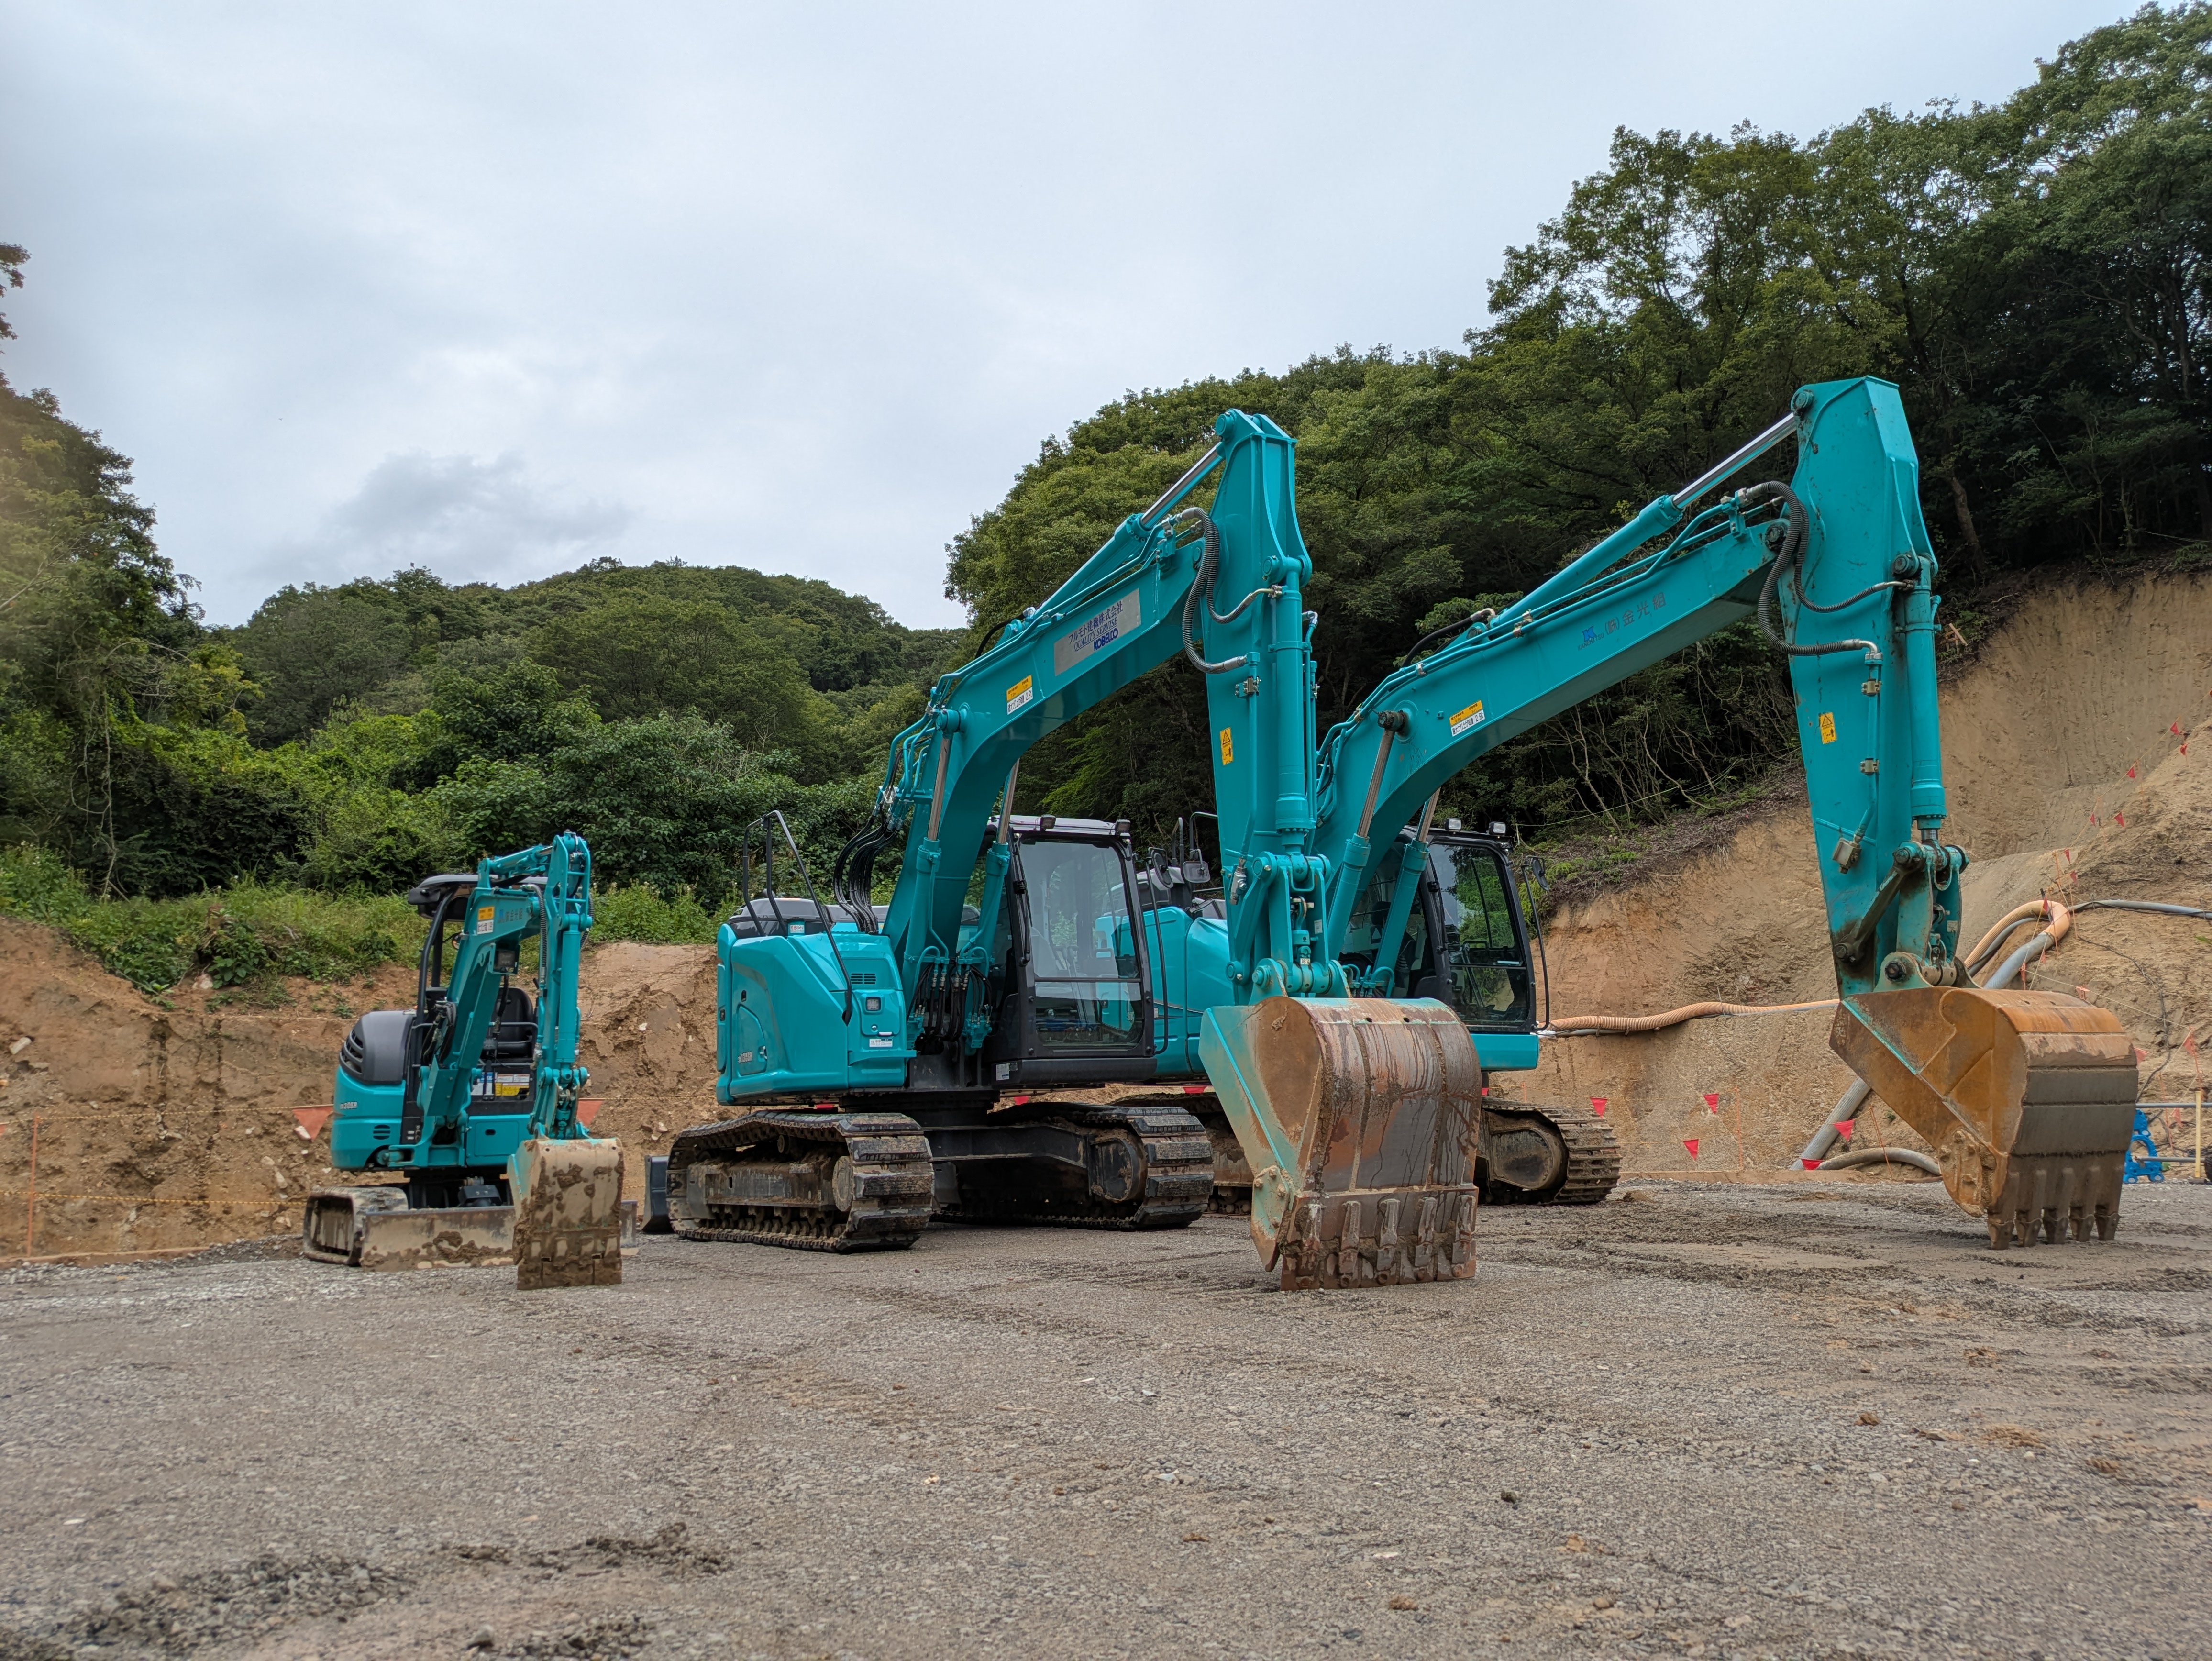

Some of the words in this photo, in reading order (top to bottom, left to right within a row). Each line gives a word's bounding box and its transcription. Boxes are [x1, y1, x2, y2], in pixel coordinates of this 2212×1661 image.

[1068, 600, 1123, 645] フルモト建機株式会社
[1074, 631, 1097, 651] QUALITY
[1094, 628, 1118, 651] KOBELCO
[1475, 712, 1483, 722] 2.9t
